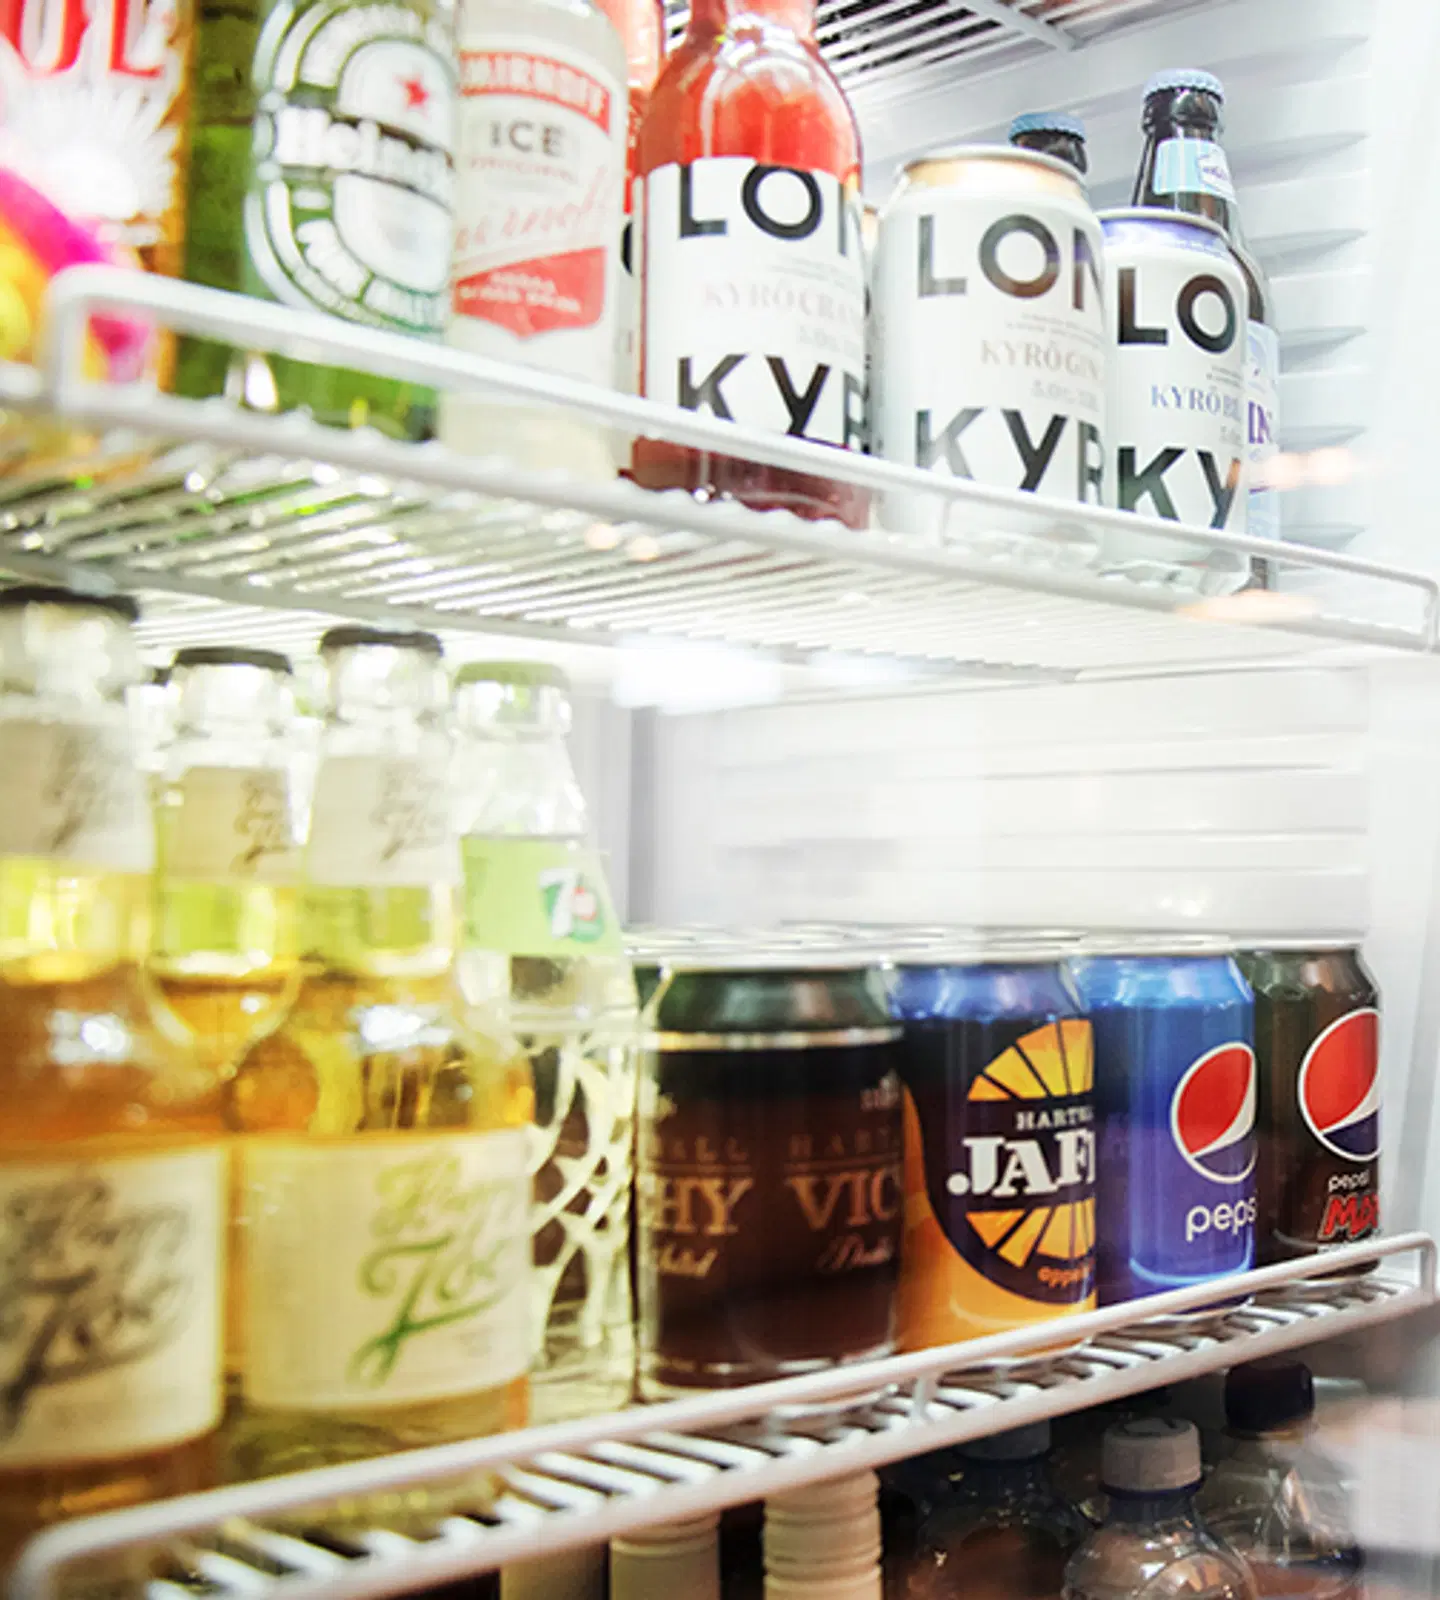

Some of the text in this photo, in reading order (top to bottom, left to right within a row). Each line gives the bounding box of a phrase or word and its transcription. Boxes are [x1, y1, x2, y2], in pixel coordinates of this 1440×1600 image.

[489, 118, 565, 158] ICE
[678, 163, 847, 257] LO
[1117, 447, 1241, 529] KY
